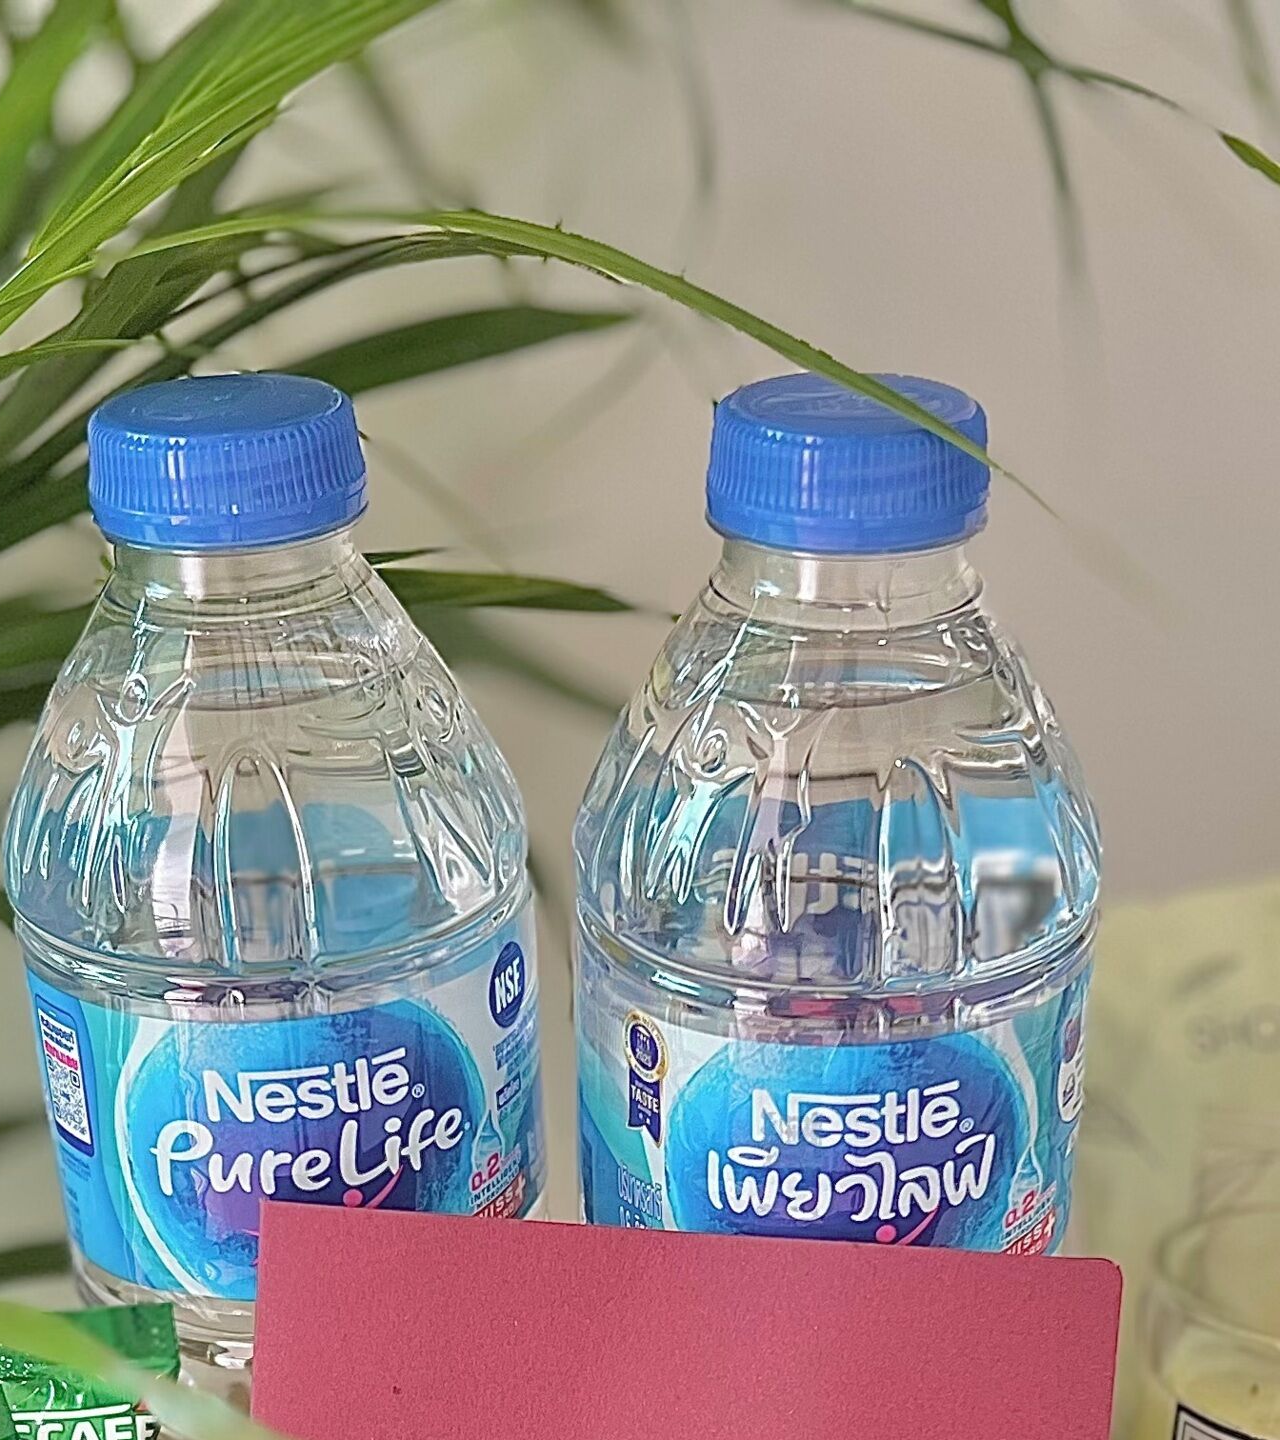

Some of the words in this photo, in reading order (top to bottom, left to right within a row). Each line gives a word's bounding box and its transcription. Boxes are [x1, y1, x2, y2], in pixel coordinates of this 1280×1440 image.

[493, 956, 522, 1015] NSF
[630, 1084, 659, 1114] TASTE
[471, 1152, 501, 1191] 0.2
